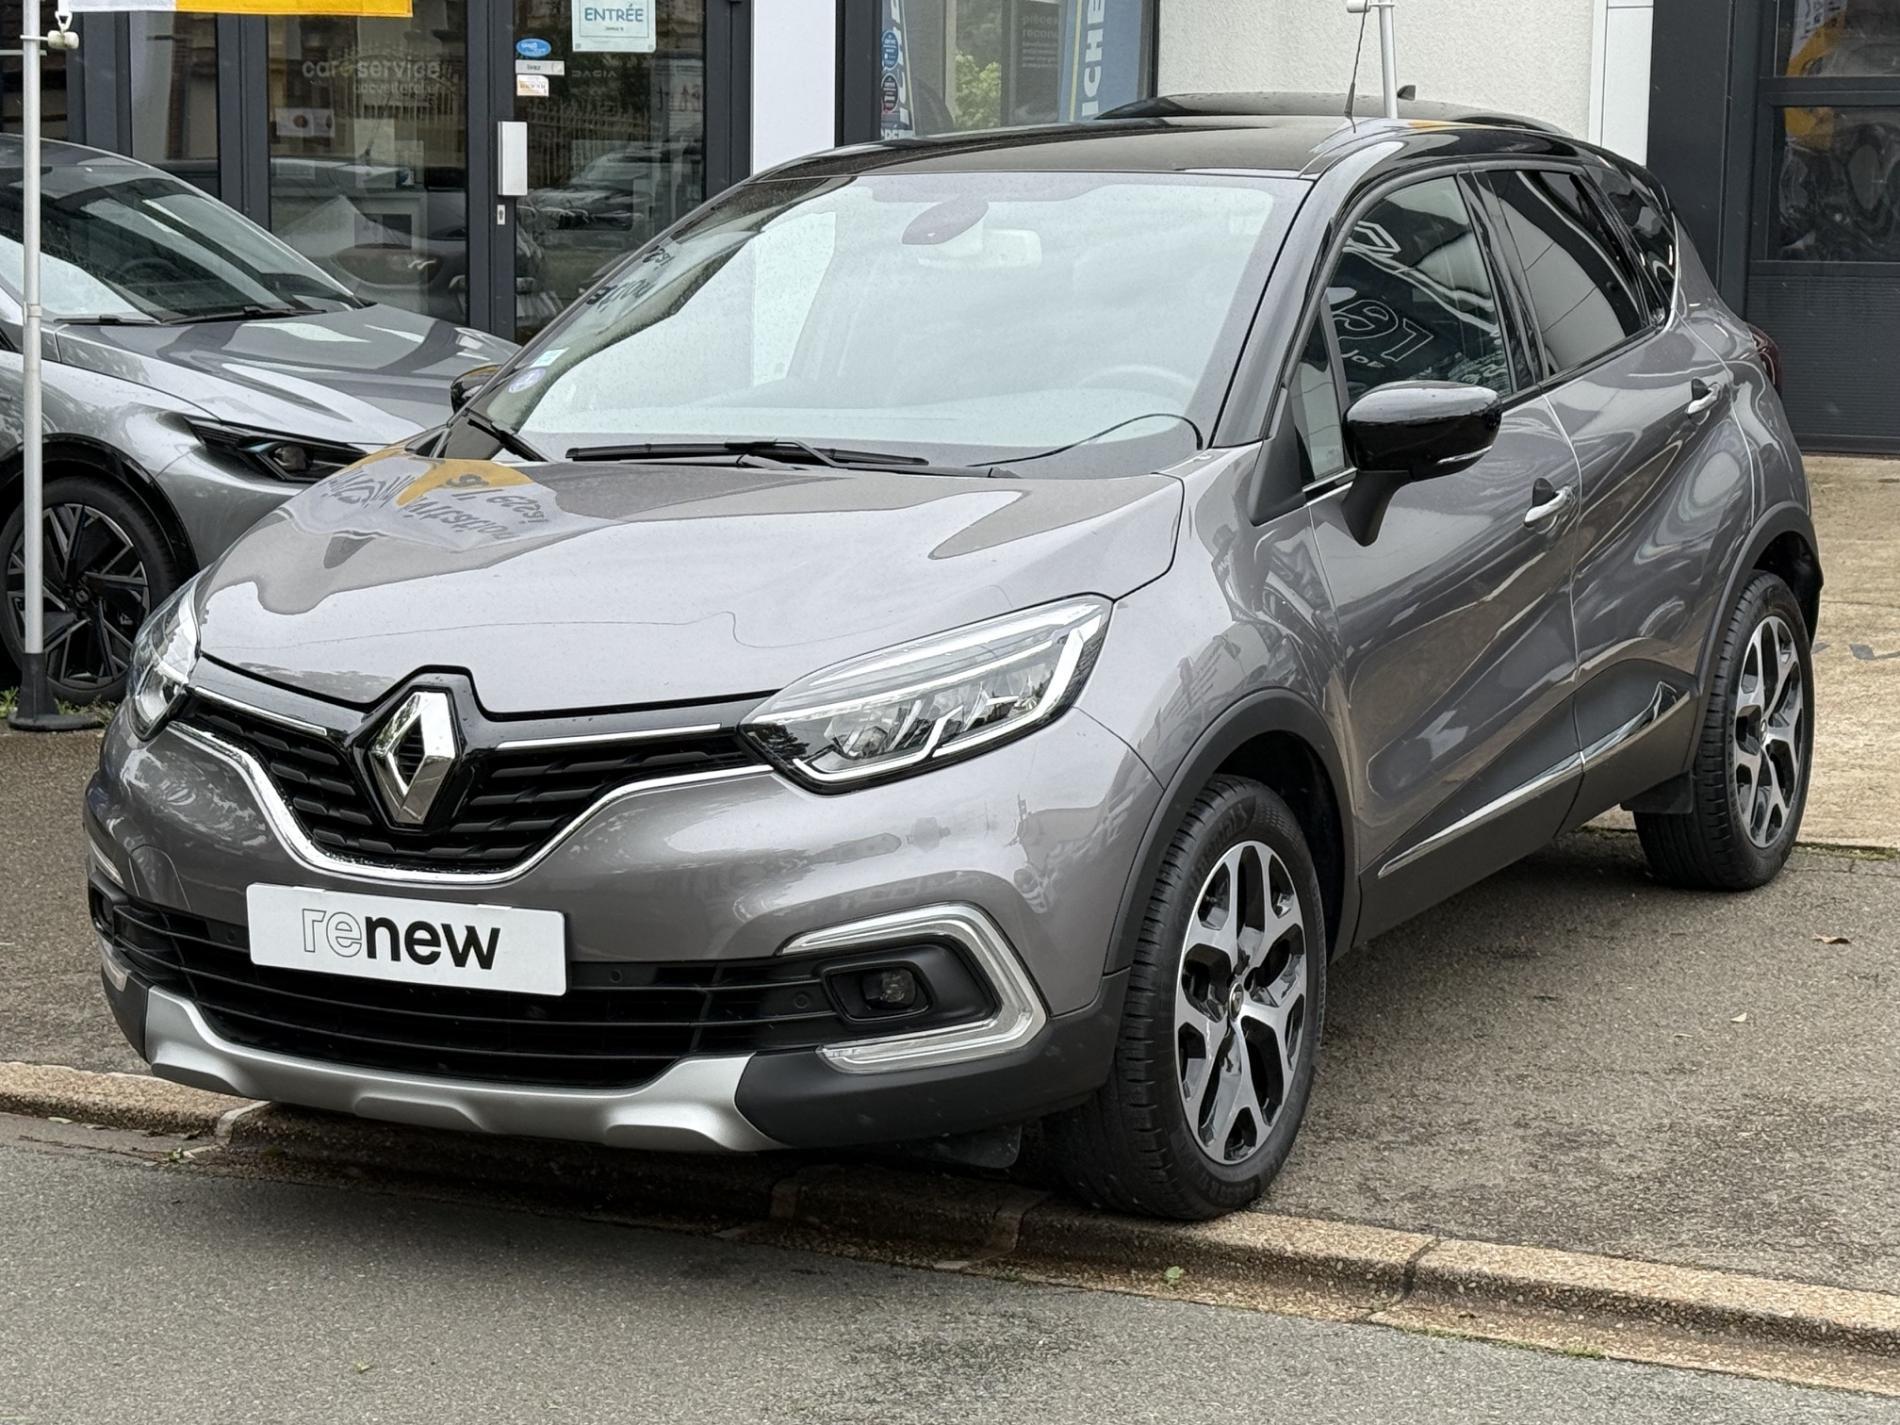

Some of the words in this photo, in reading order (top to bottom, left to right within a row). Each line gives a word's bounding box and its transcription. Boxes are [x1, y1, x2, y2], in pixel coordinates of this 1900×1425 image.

[584, 3, 644, 22] ENTRÉE
[357, 55, 441, 78] service
[571, 69, 617, 79] DACIA
[302, 908, 501, 970] renew
